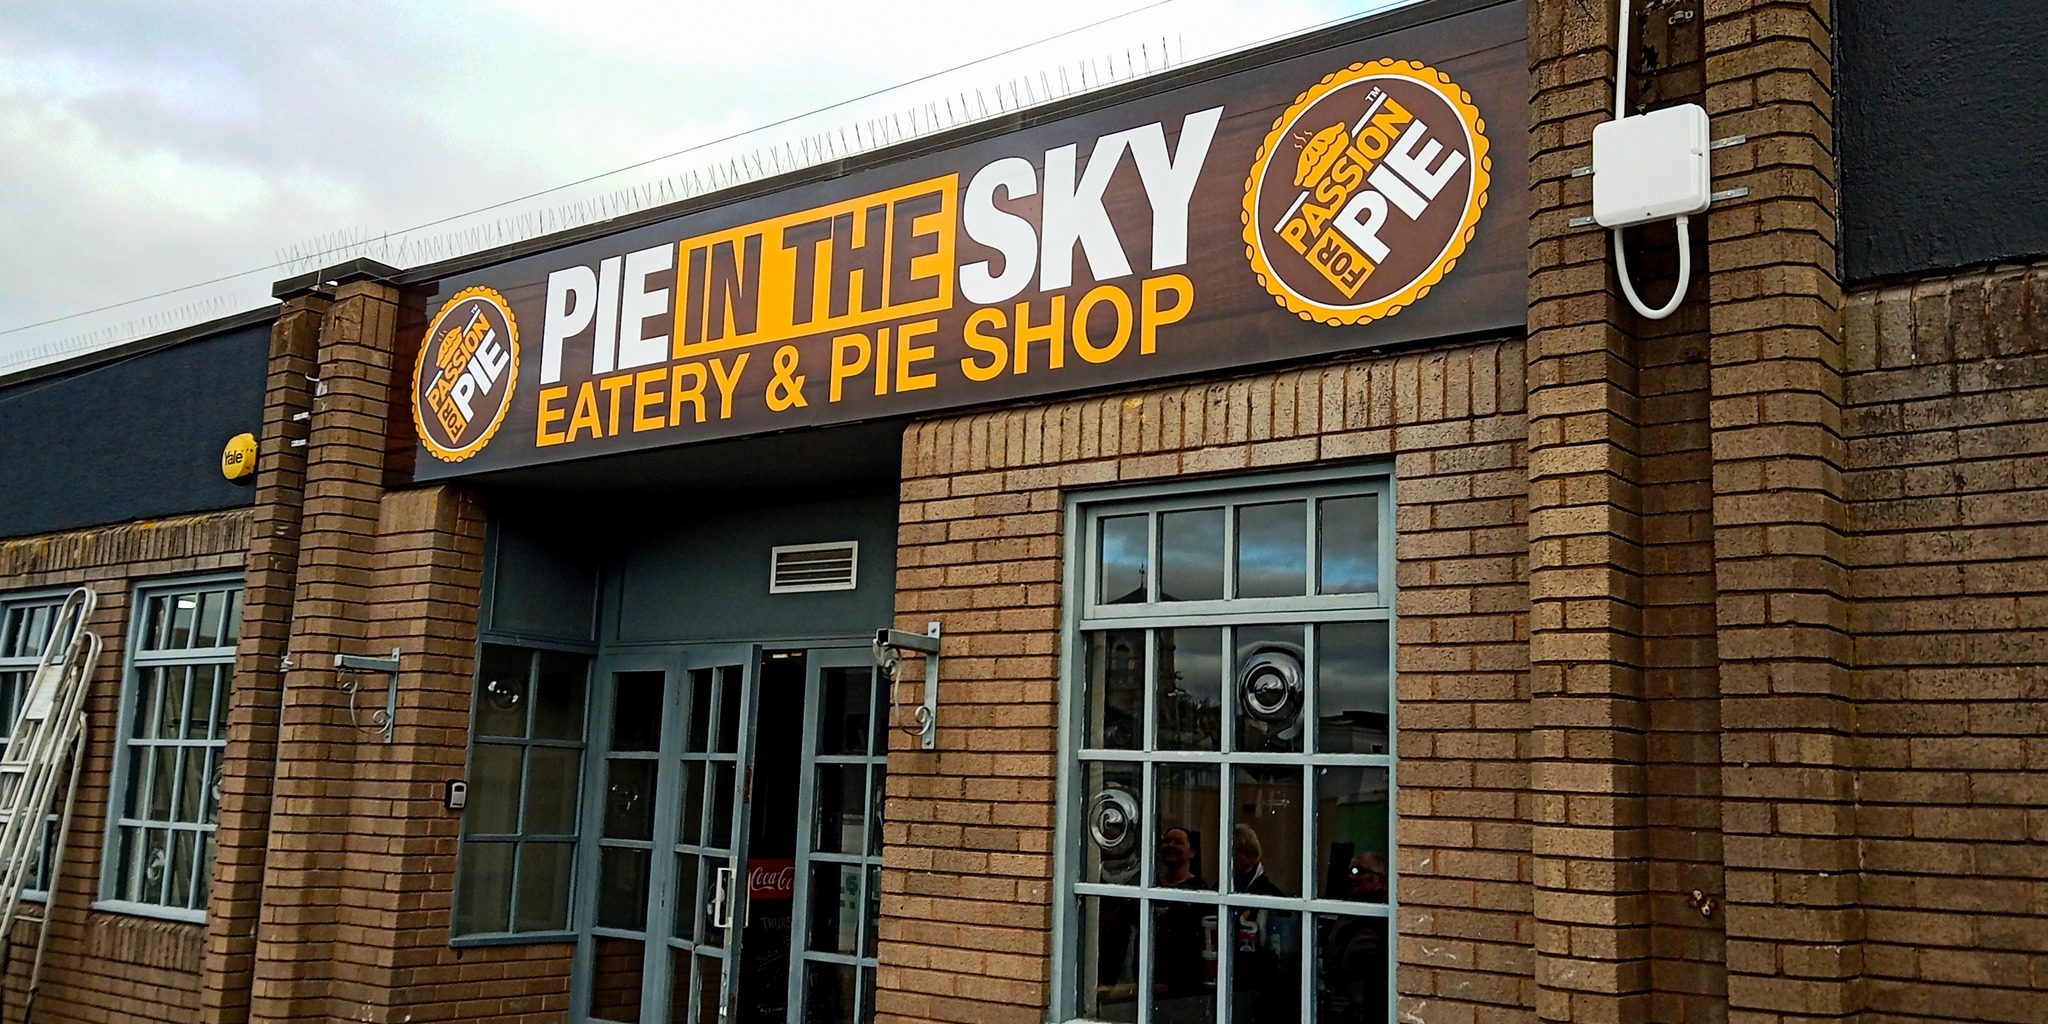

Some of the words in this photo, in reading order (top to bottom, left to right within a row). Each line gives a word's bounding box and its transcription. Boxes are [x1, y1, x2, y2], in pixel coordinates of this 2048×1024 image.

[1280, 97, 1414, 255] PASSION
[1332, 119, 1467, 265] PIE
[540, 242, 674, 385] PIE
[684, 232, 763, 346] IN
[781, 189, 943, 328] THE
[959, 105, 1225, 304] SKY
[1316, 236, 1367, 289] FOR
[426, 313, 491, 414] PASSION
[450, 329, 510, 423] PIE
[535, 352, 750, 447] EATERY
[765, 344, 809, 412] &
[829, 318, 938, 403] PIE
[960, 273, 1195, 382] SHOP
[225, 450, 243, 466] Yale
[442, 398, 463, 440] FOR
[750, 866, 795, 891] Coca-Co
